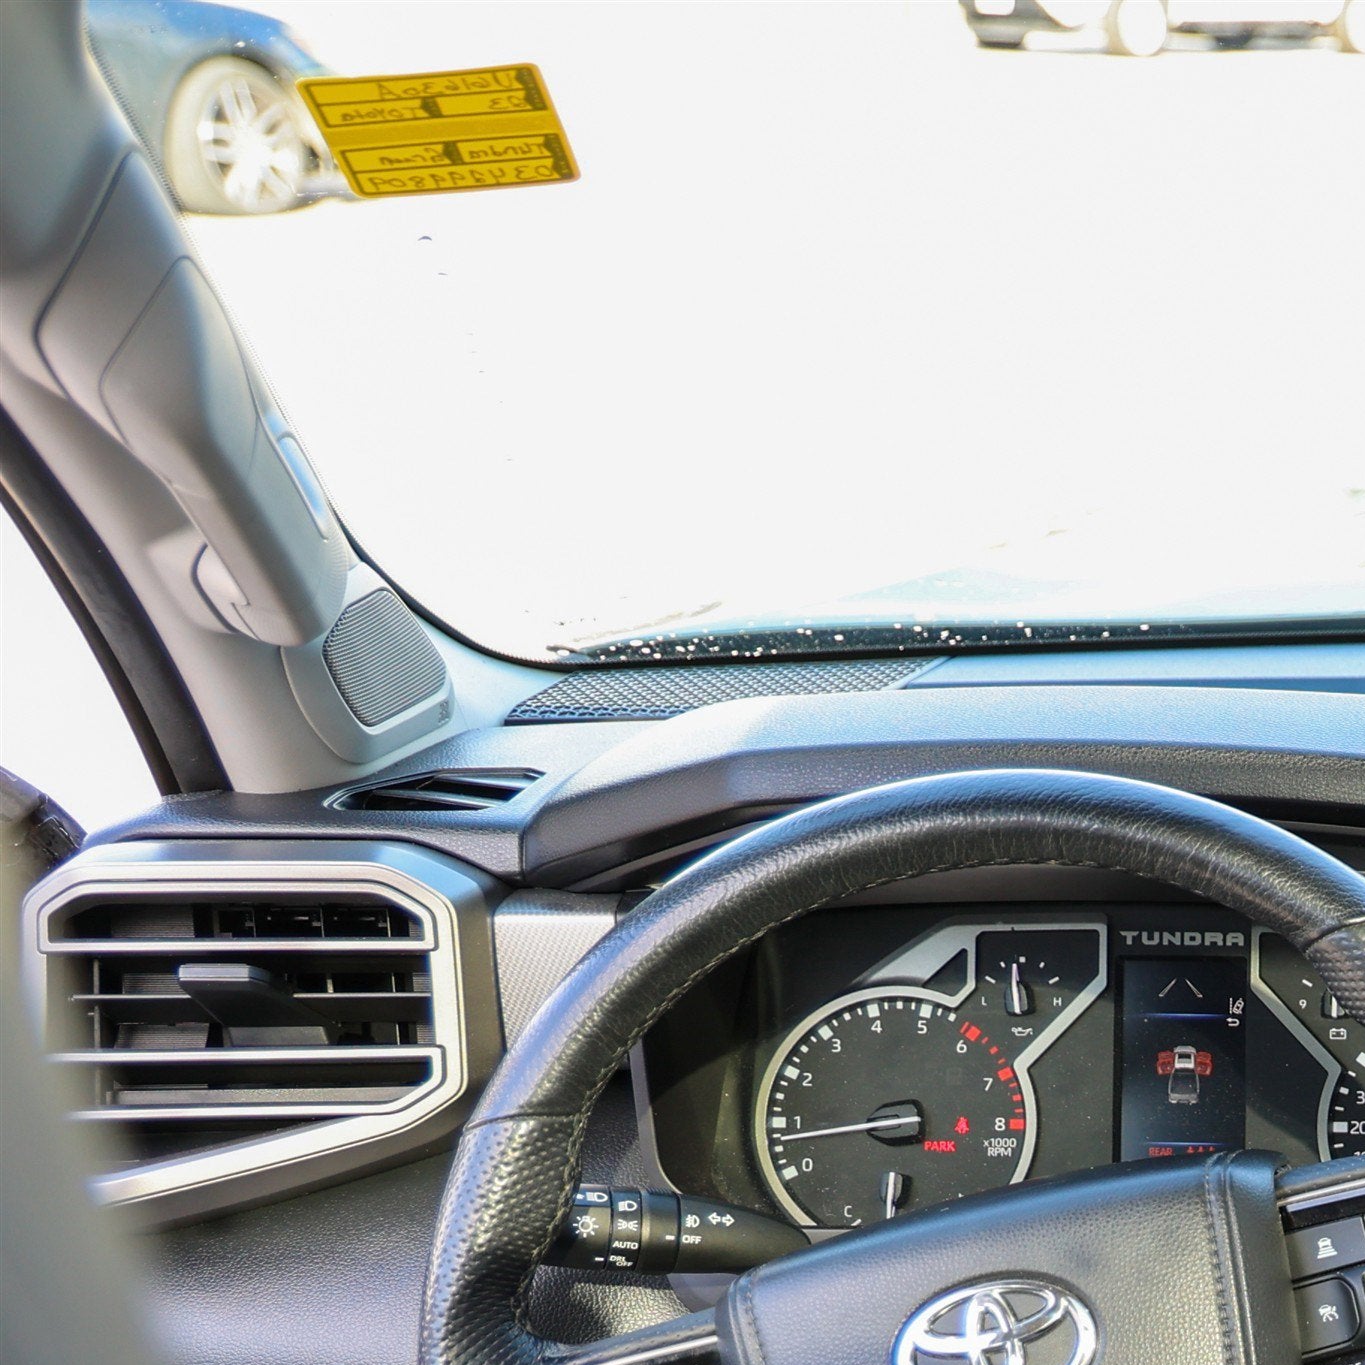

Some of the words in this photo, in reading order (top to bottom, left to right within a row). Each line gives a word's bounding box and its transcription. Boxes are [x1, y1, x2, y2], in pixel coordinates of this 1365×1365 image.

[1119, 930, 1245, 947] TUNDRA
[981, 997, 987, 1006] L
[1053, 997, 1062, 1006] H
[1299, 999, 1307, 1008] 9
[870, 1020, 883, 1033] 4
[917, 1020, 928, 1034] 5
[831, 1039, 842, 1052] 3
[956, 1040, 968, 1053] 6
[802, 1073, 813, 1086] 2
[983, 1078, 993, 1091] 7
[793, 1116, 801, 1129] 1
[994, 1117, 1006, 1131] 8
[924, 1141, 956, 1152] PARK
[982, 1138, 1017, 1148] x1000
[987, 1147, 1012, 1157] RPM
[1149, 1147, 1173, 1156] REAR
[802, 1158, 813, 1171] 0
[844, 1205, 852, 1217] C
[613, 1241, 638, 1250] AUTO
[682, 1235, 702, 1244] OFF
